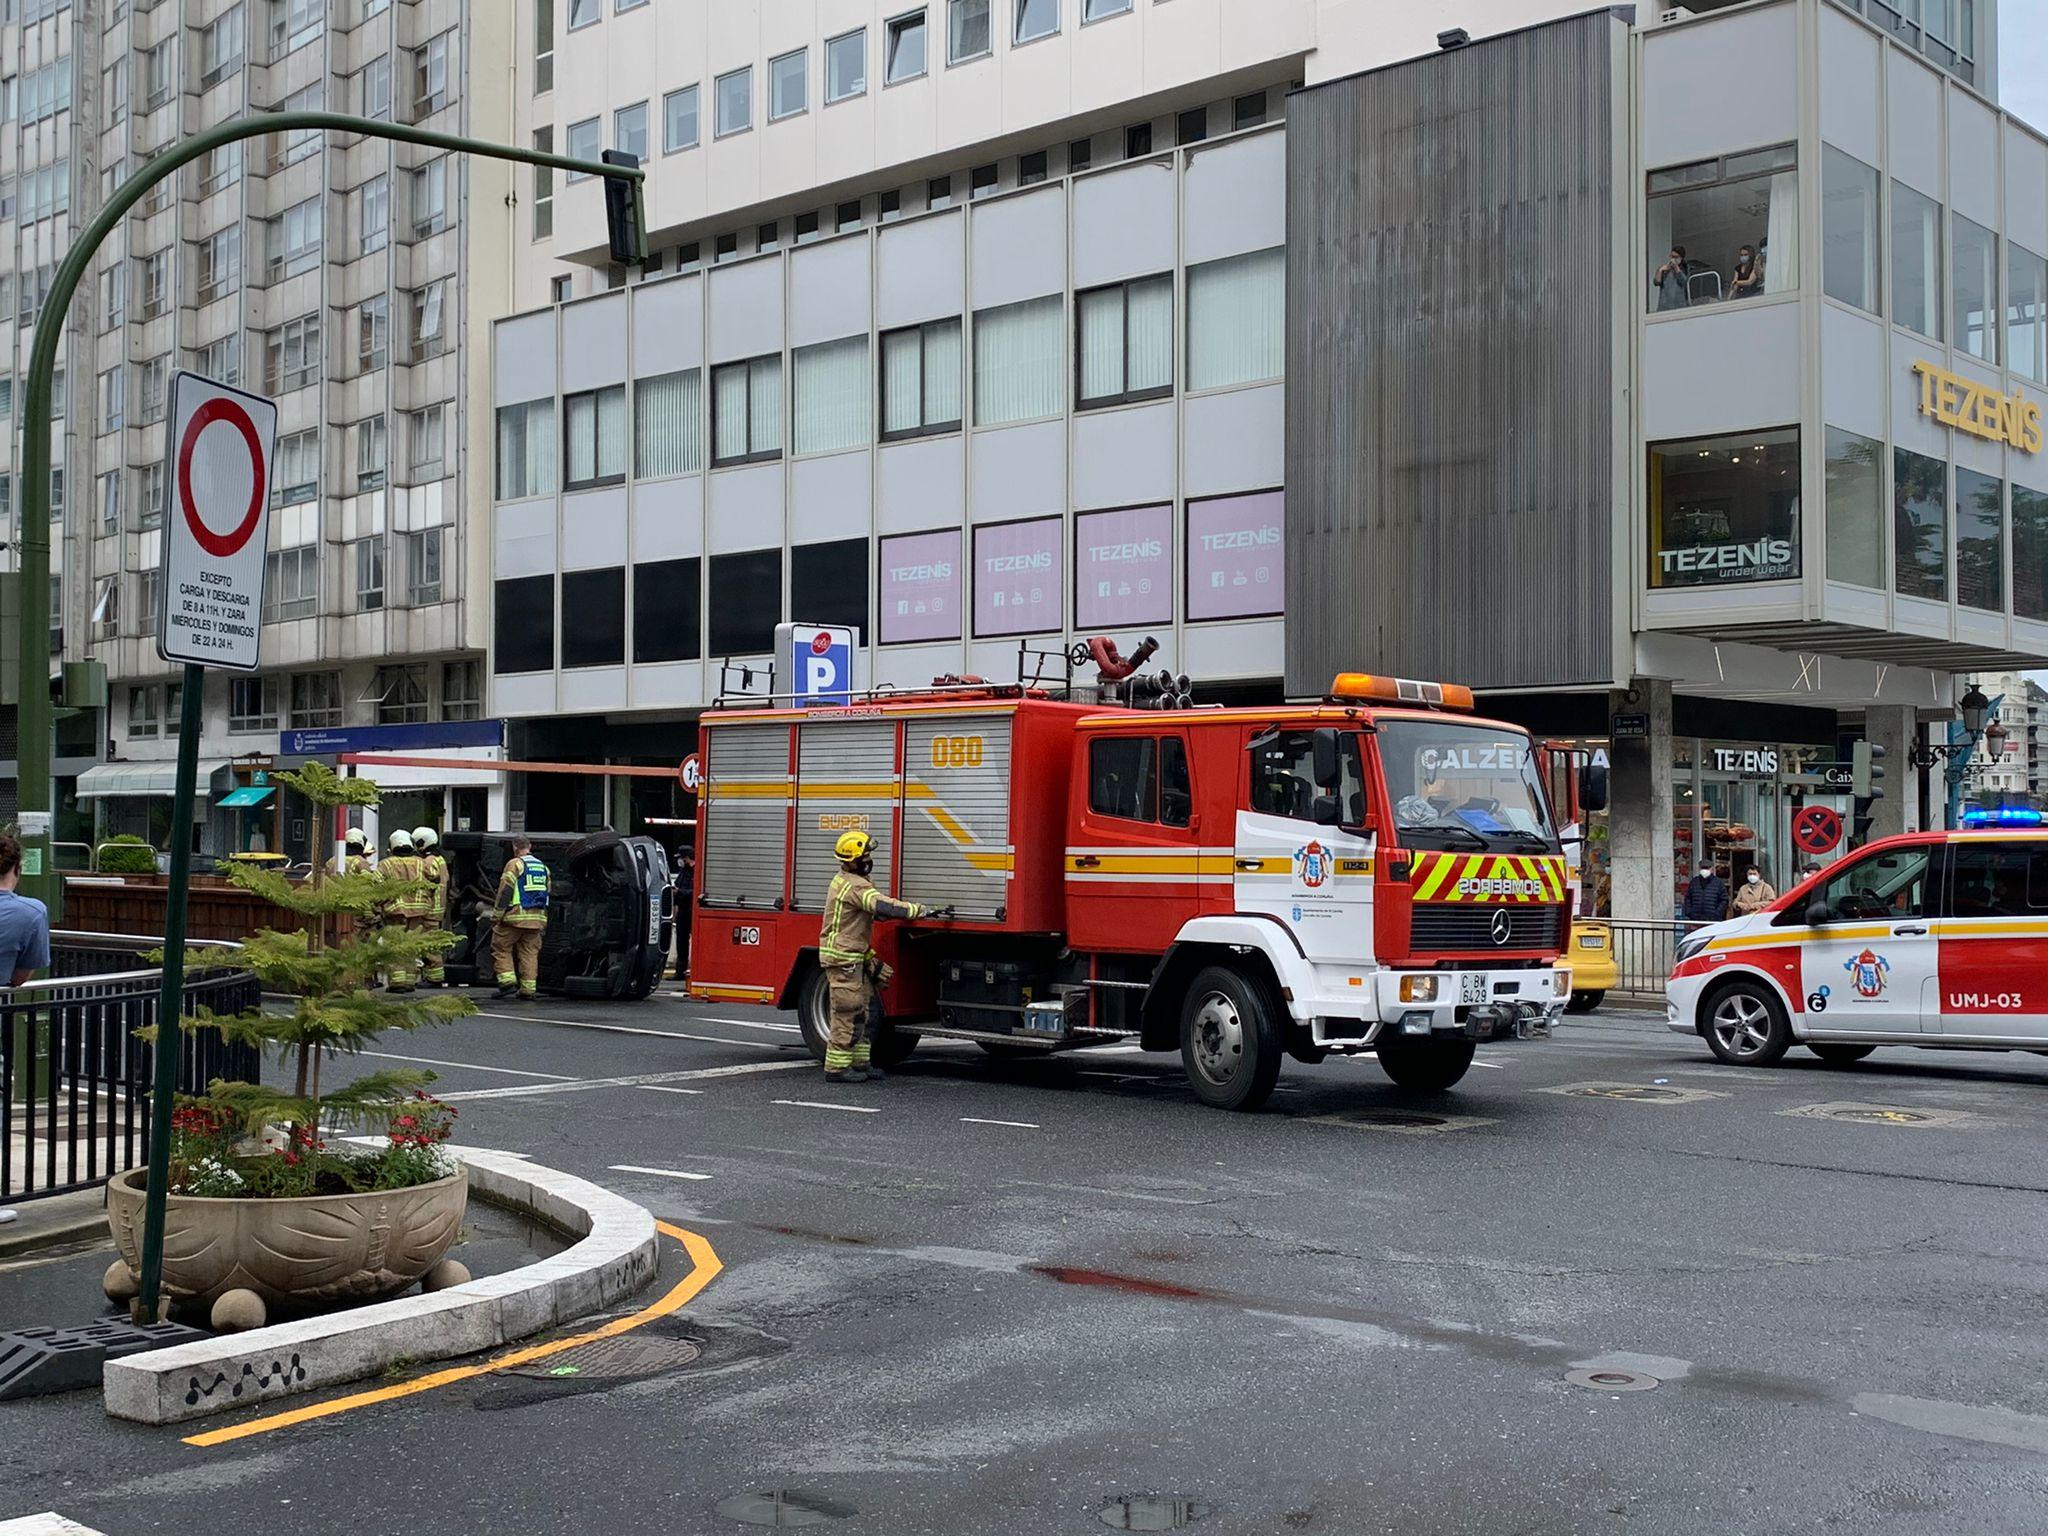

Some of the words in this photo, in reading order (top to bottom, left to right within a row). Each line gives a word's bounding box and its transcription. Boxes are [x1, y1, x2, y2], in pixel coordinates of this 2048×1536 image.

[200, 571, 232, 587] EXCEPTO
[1719, 563, 1792, 578] underwear
[179, 583, 205, 598] CARGA
[206, 588, 211, 599] Y
[212, 589, 250, 606] DESCARGA
[182, 599, 193, 611] DE
[193, 602, 198, 613] 8
[199, 603, 205, 614] A
[221, 607, 226, 617] Y
[227, 608, 246, 621] ZARA
[212, 621, 217, 632] Y
[218, 622, 255, 638] DOMINGOS
[192, 633, 201, 645] DE
[202, 635, 210, 647] 22
[211, 637, 217, 648] A
[218, 638, 226, 649] 24
[807, 657, 836, 699] P
[931, 735, 984, 768] 080
[1714, 746, 1778, 773] TEZENIS
[1462, 989, 1487, 1004] 6429
[1949, 993, 2023, 1008] UMJ-03
